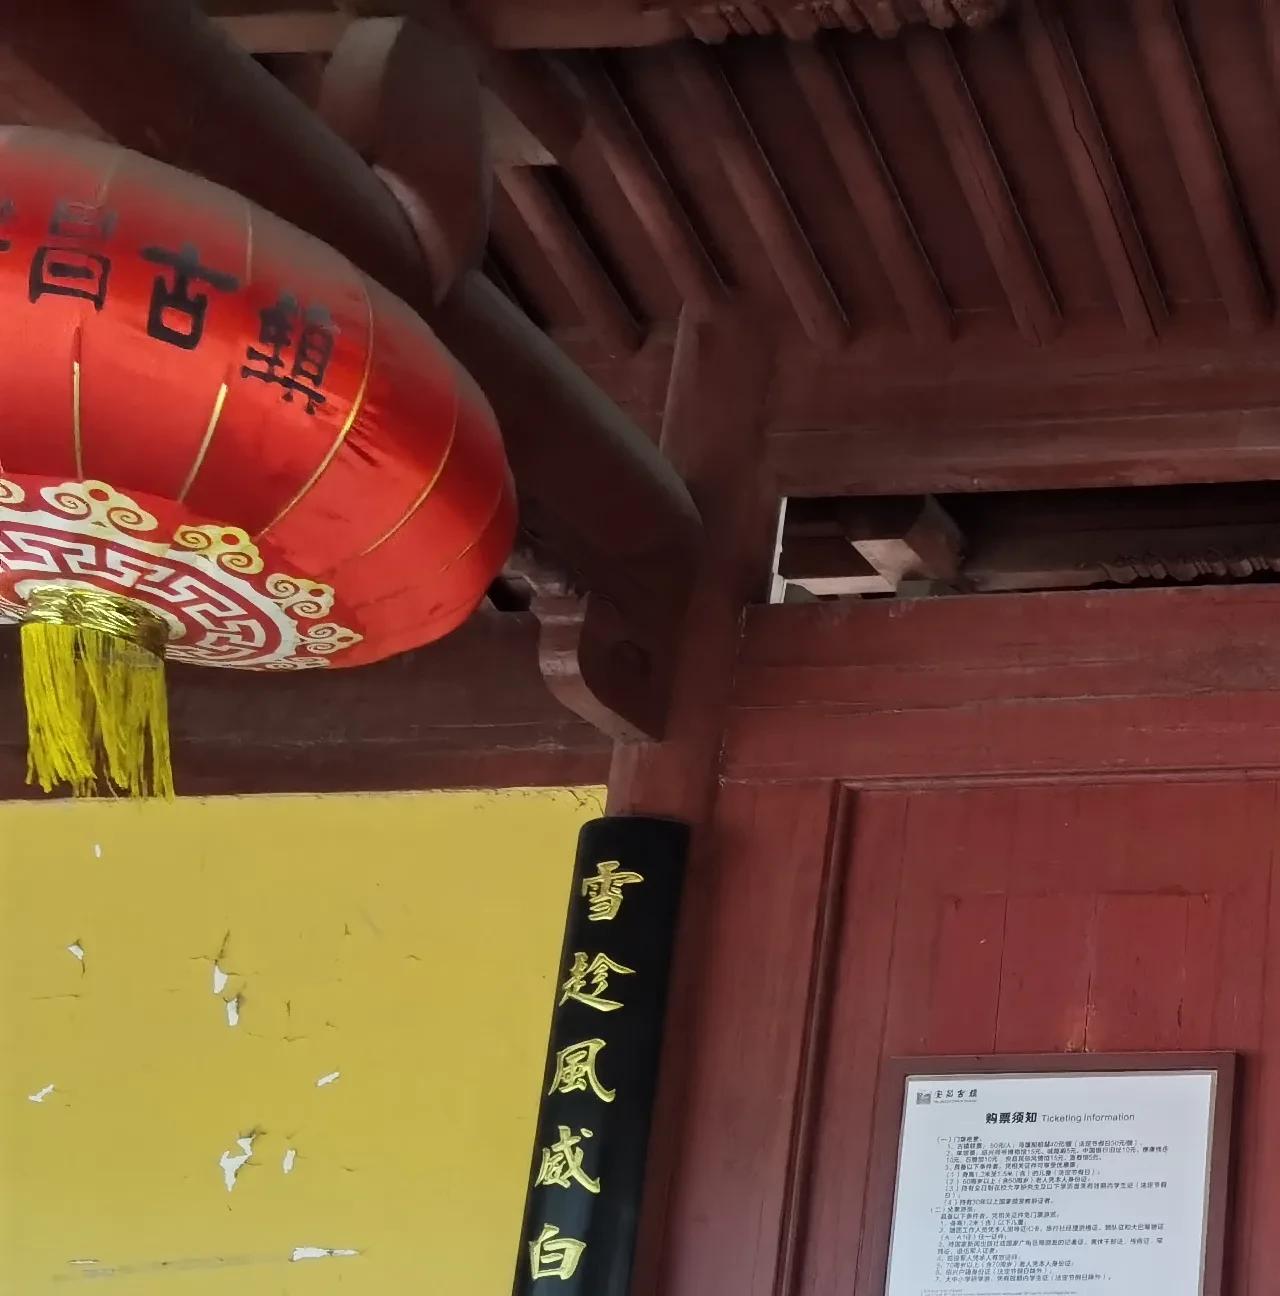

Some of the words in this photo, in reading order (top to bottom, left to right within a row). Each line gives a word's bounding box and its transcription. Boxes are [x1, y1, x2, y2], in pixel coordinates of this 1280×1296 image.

[0, 195, 335, 416] 昌古鎮
[985, 1111, 1037, 1124] 购票须知
[1042, 1114, 1082, 1123] Ticketing
[1084, 1113, 1135, 1122] Information
